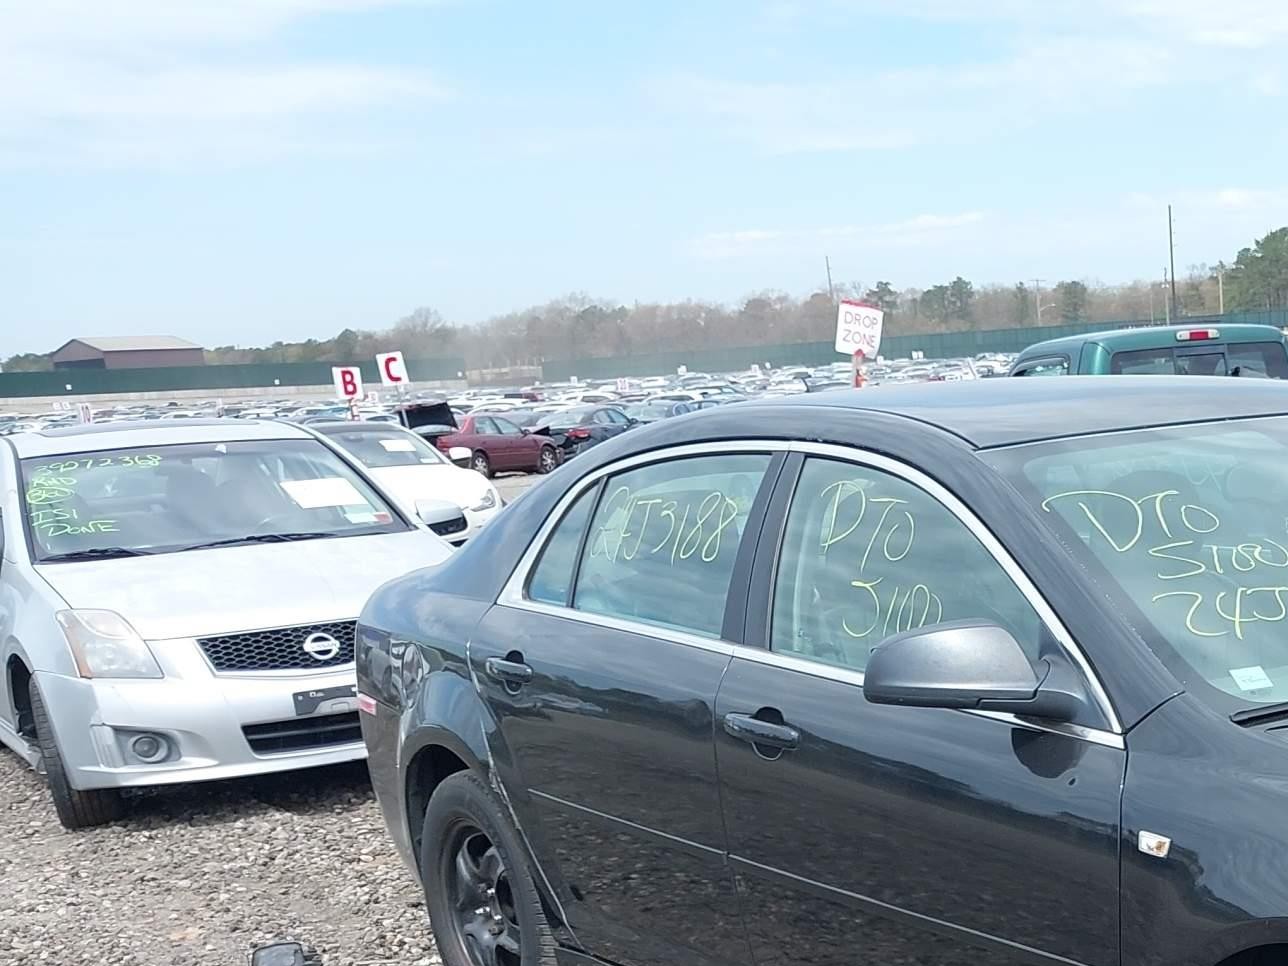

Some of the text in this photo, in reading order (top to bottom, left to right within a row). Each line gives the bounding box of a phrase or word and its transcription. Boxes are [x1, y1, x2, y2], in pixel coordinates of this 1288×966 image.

[844, 311, 878, 329] DROP
[842, 329, 876, 348] ZONE
[385, 357, 402, 382] C
[341, 370, 357, 395] B
